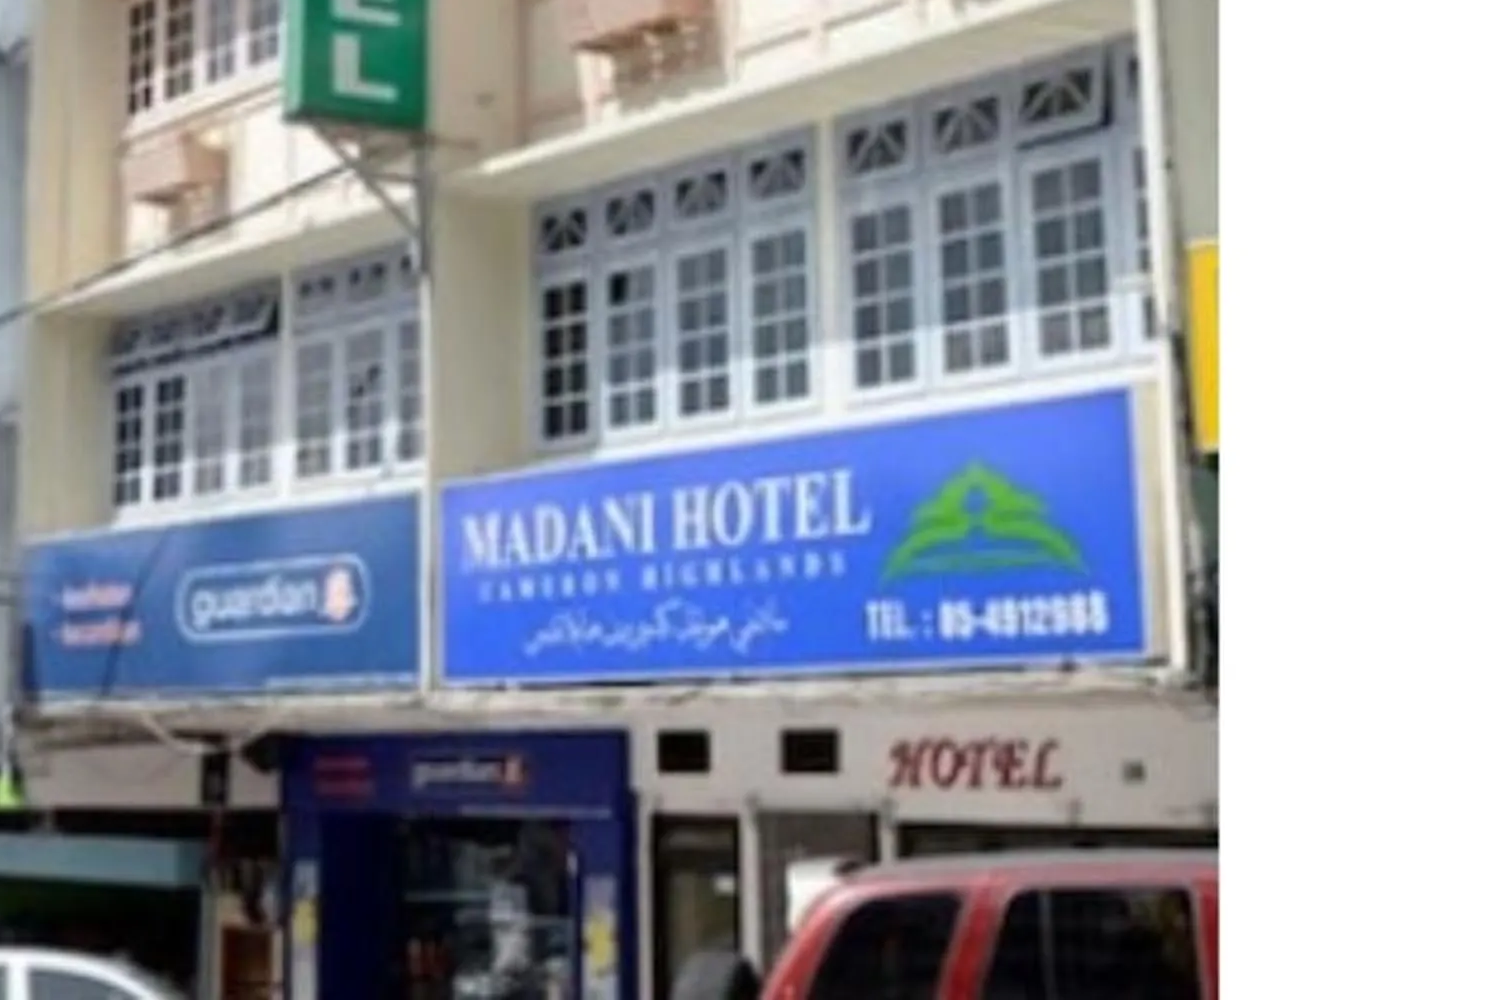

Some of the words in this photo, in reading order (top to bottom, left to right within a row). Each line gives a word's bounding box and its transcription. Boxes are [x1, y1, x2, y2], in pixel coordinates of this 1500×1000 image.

[461, 491, 657, 572] MADANI
[671, 467, 872, 551] HOTEL
[191, 573, 318, 632] guardian
[889, 738, 1063, 790] HOTEL
